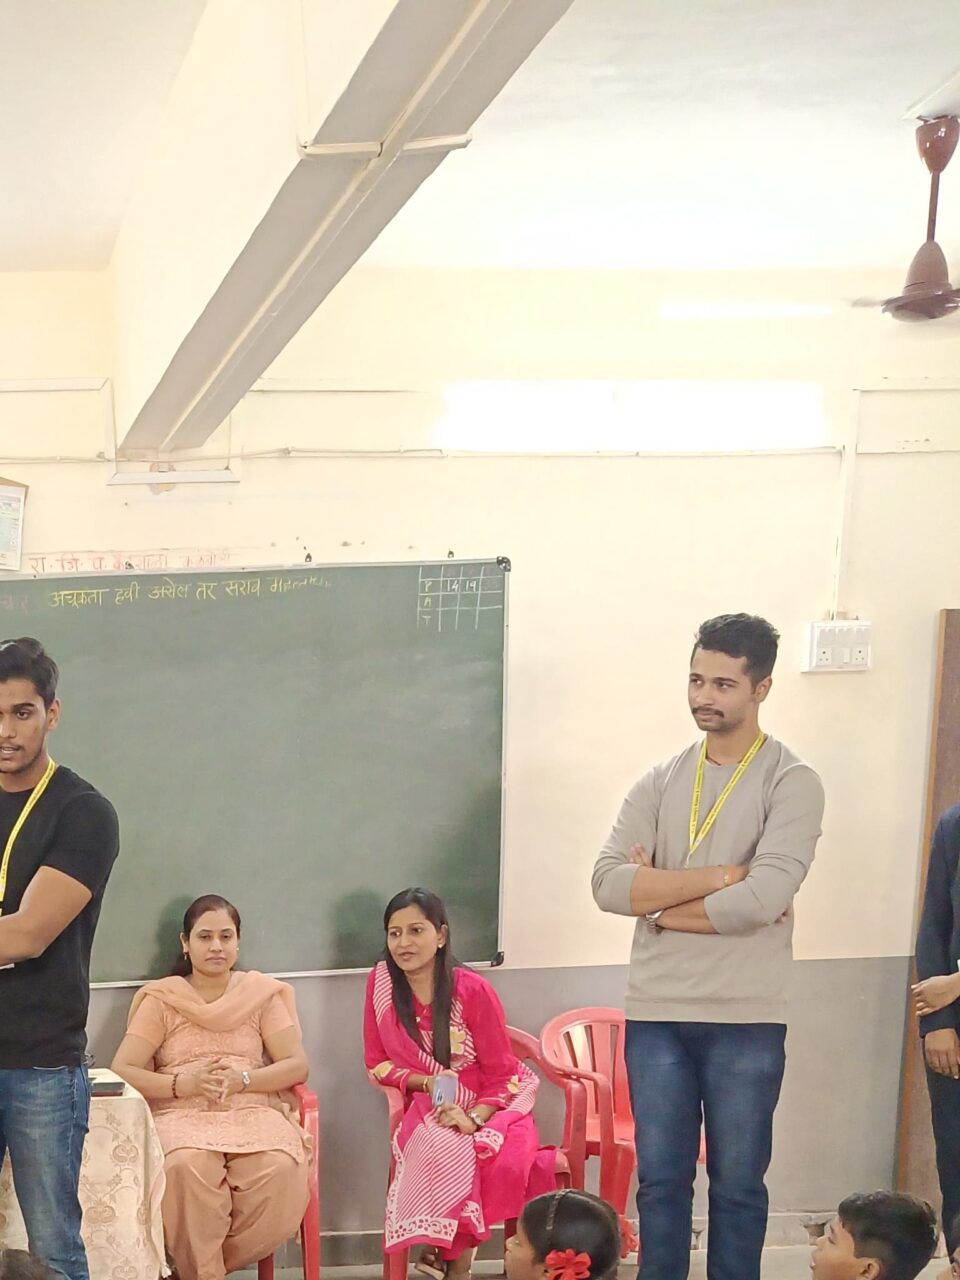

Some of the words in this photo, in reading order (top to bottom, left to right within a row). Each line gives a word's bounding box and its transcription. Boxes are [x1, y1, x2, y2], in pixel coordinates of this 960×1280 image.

[50, 588, 110, 608] अचूकता
[113, 581, 140, 605] हवी
[148, 577, 192, 599] असेल
[196, 582, 218, 600] तर
[222, 578, 260, 597] सराव
[447, 580, 459, 592] 14
[466, 580, 477, 592] 19
